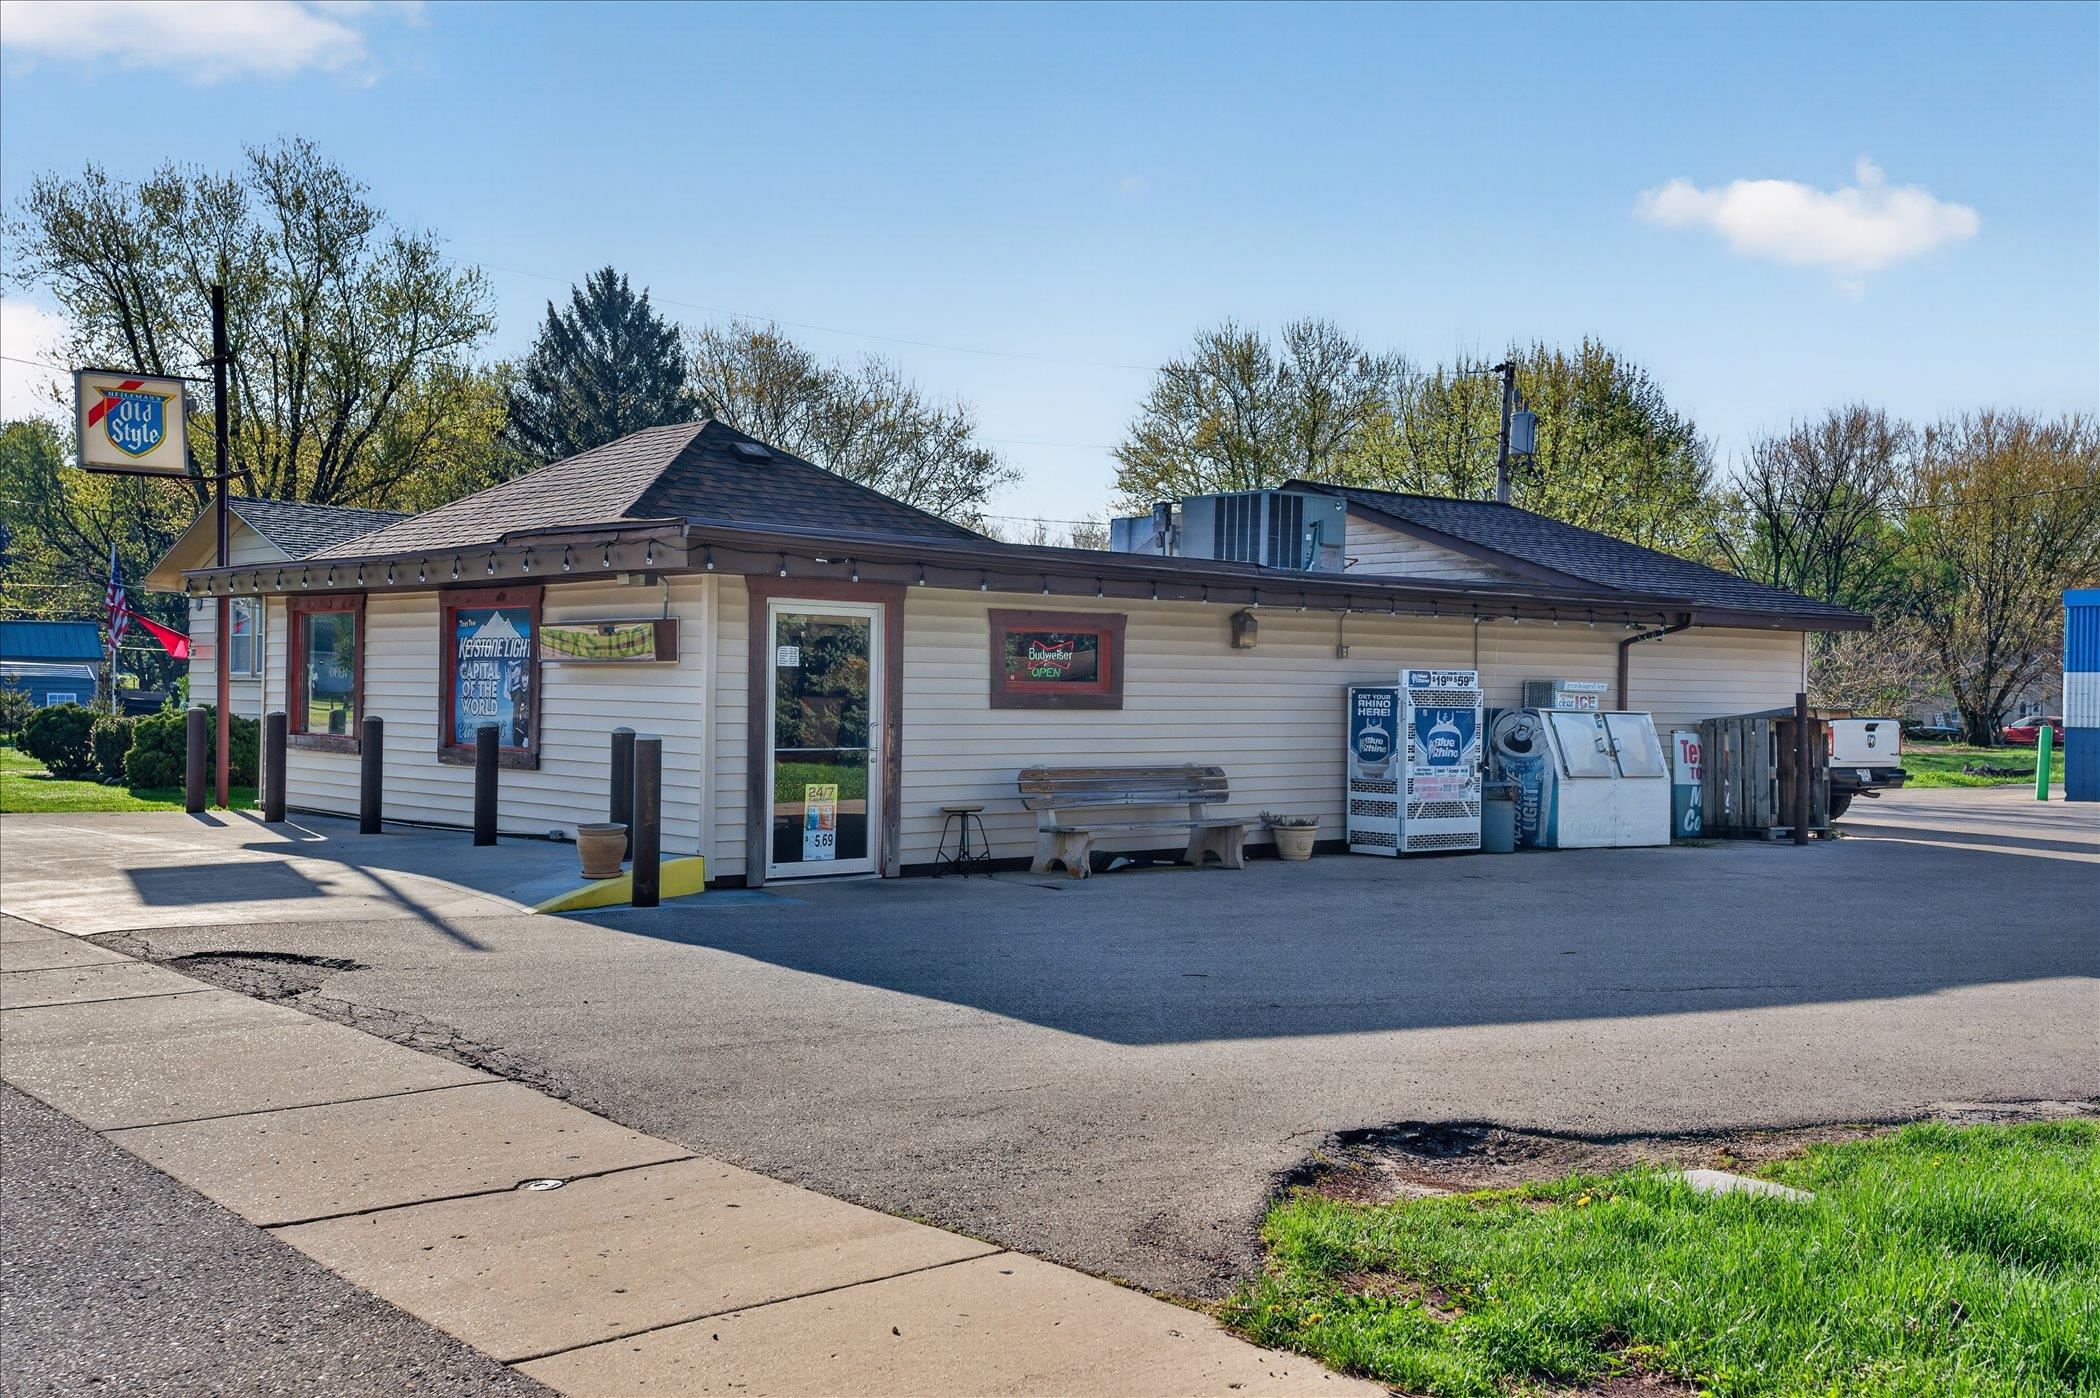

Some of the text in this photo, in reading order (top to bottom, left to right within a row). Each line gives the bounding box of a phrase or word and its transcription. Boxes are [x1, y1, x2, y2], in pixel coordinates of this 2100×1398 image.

[120, 400, 152, 422] Old
[111, 418, 160, 451] Style
[459, 636, 504, 660] KEYSTONE
[1028, 647, 1073, 660] Budweiser
[460, 661, 501, 680] CAPITAL
[1031, 667, 1062, 678] OPEN
[462, 679, 498, 698] OF THE
[460, 698, 498, 716] WORLD
[1357, 699, 1392, 708] RHINO
[1357, 707, 1391, 717] HERE!
[808, 787, 835, 798] 24/7
[1523, 786, 1539, 831] LIGHT
[814, 833, 834, 848] 5.69
